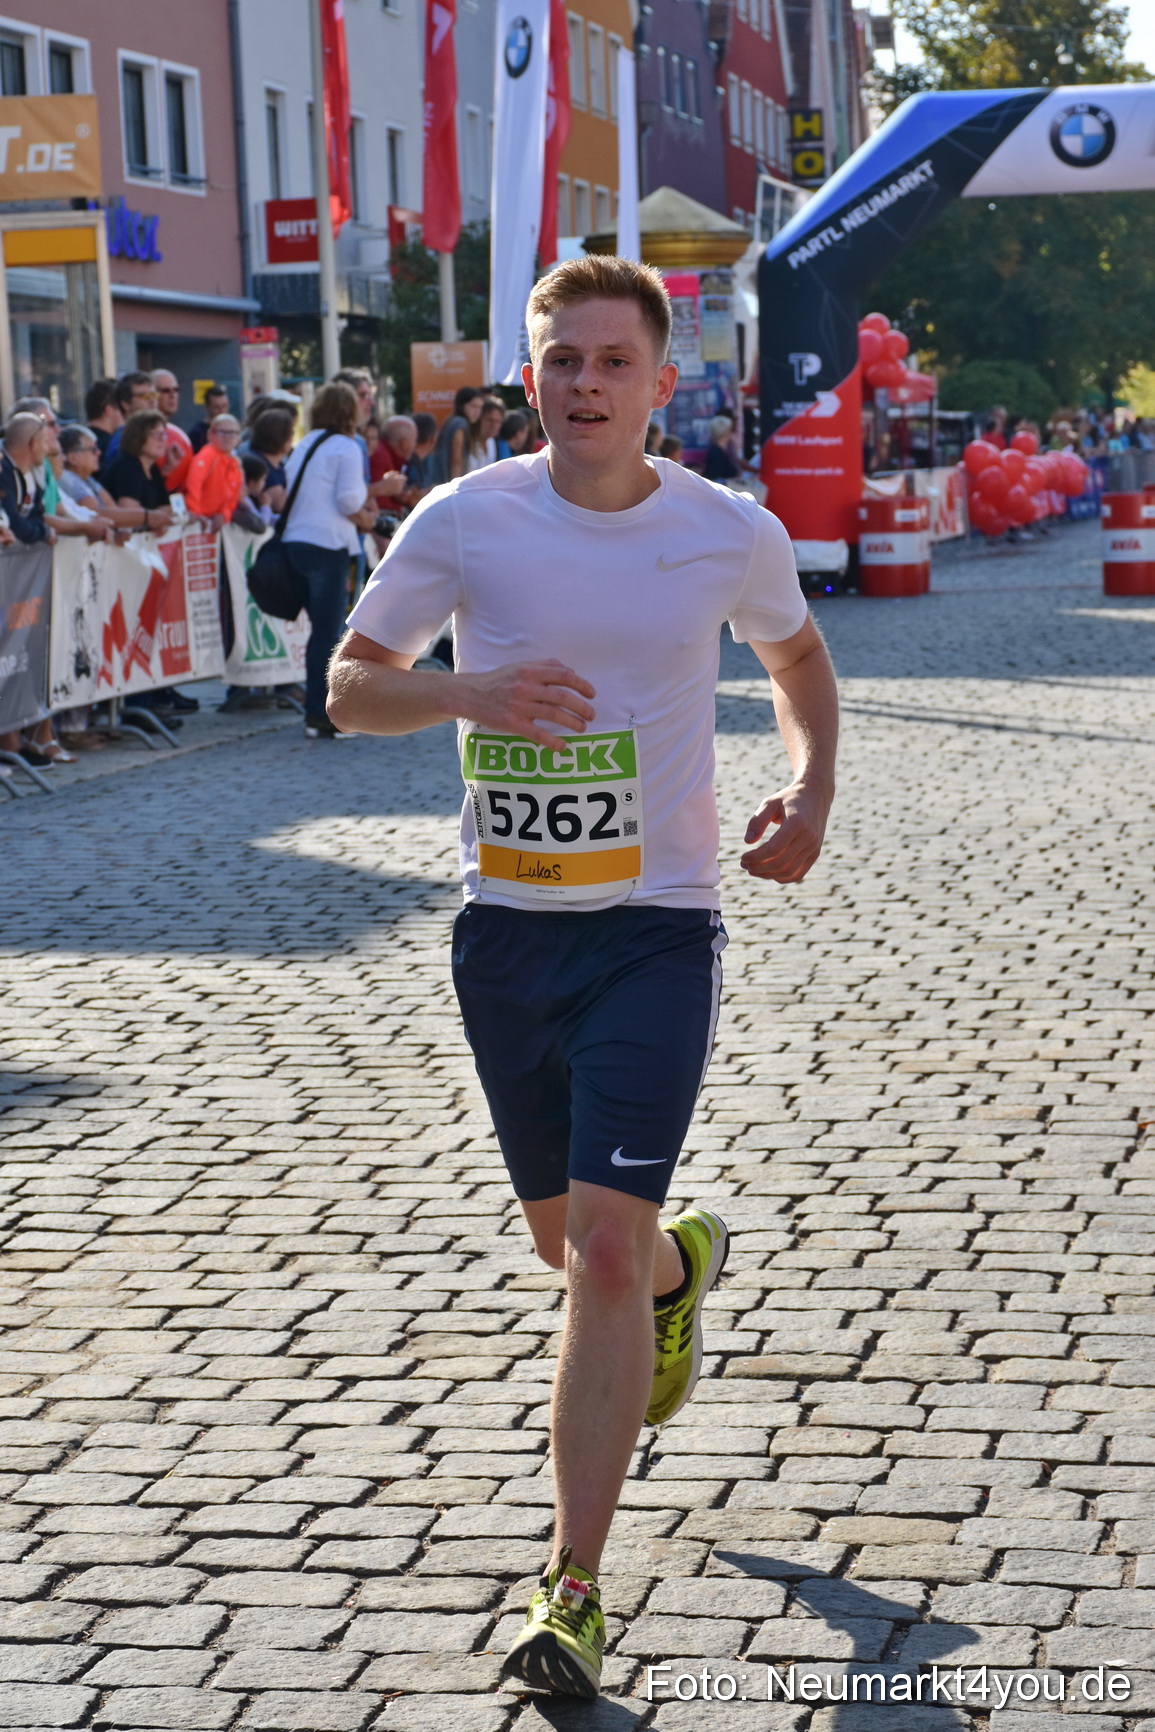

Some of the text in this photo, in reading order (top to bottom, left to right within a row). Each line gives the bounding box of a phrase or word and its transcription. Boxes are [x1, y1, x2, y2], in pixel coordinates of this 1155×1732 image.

[793, 112, 824, 192] HO
[787, 159, 934, 270] PARTL NEUMARKT
[475, 739, 624, 778] BOCK
[487, 790, 620, 843] 5262
[516, 853, 562, 880] Lukas
